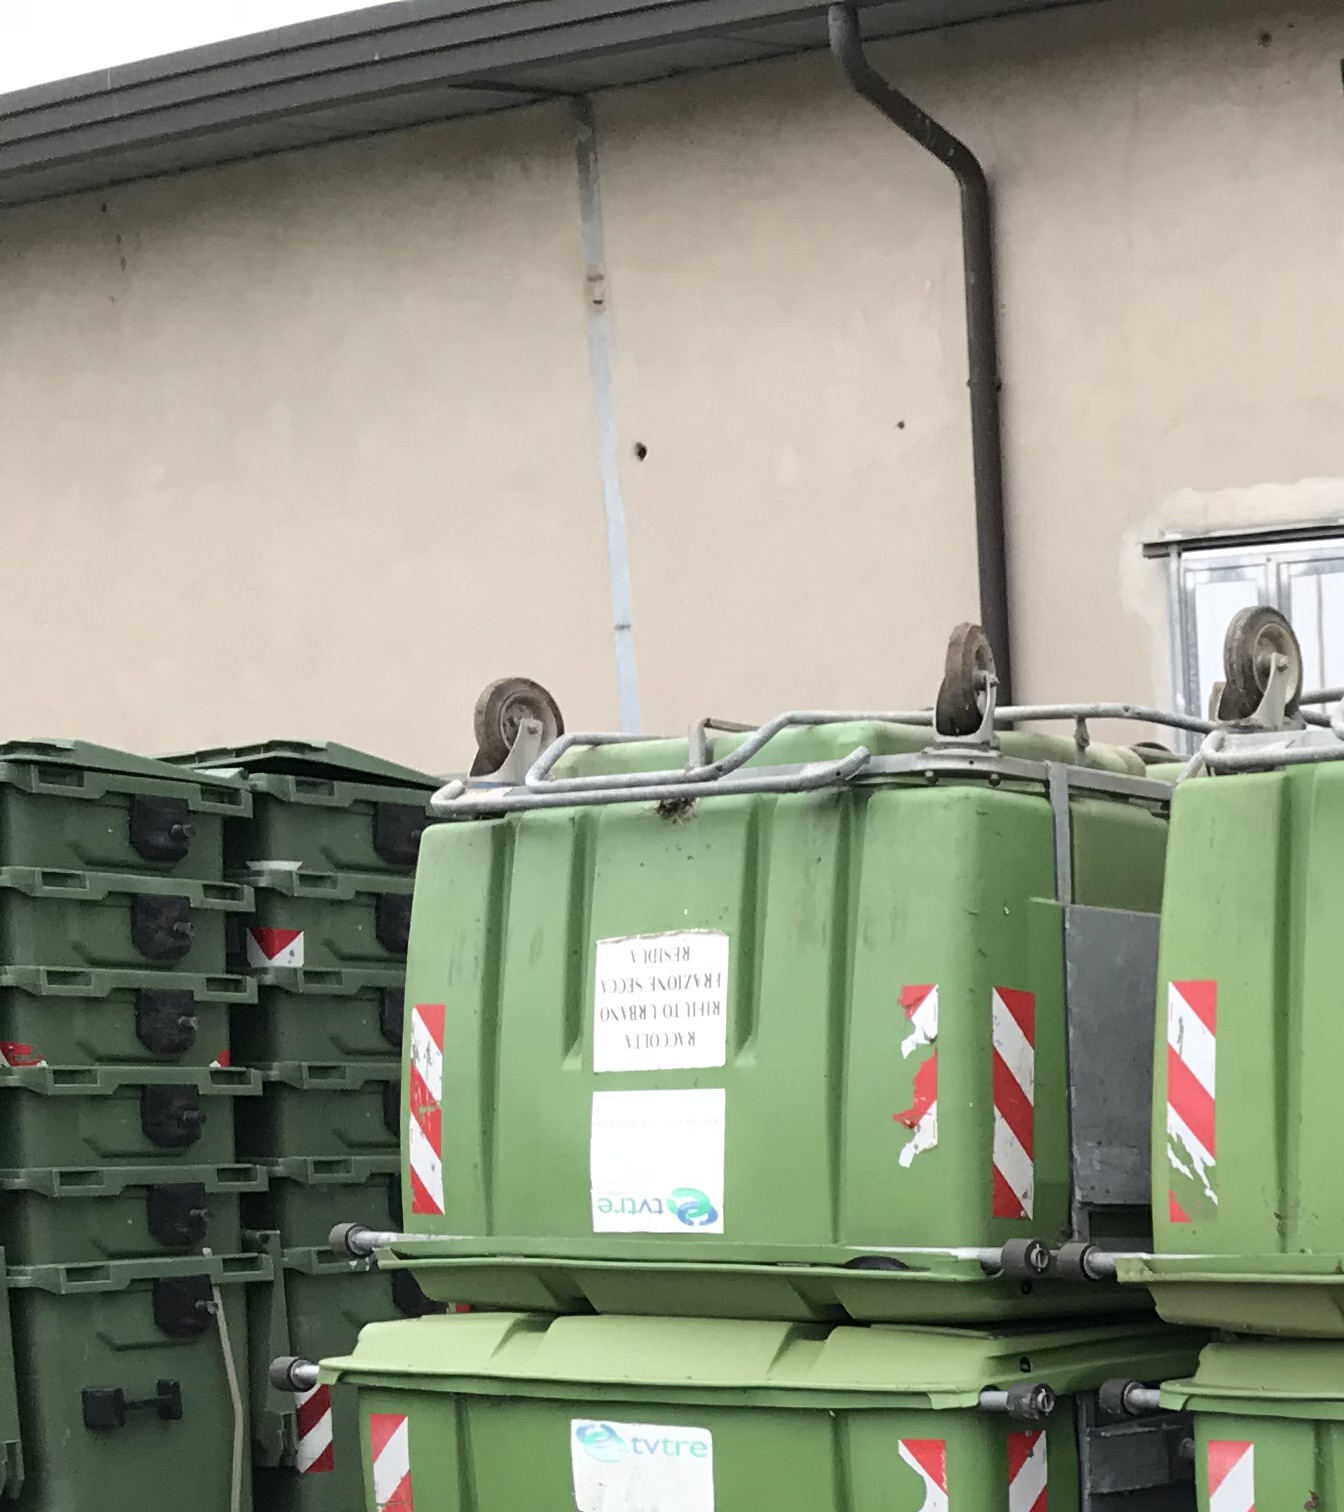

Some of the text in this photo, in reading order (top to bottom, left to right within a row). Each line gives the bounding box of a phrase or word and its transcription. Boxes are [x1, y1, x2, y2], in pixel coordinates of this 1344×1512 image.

[630, 947, 690, 964] RESIDUA
[601, 973, 721, 994] FRAZIONE SECCA
[600, 1001, 720, 1022] RIFIUTO URBANO
[625, 1032, 696, 1049] RACCOLTA
[598, 1198, 664, 1216] tvtre
[631, 1435, 708, 1458] tvtre
